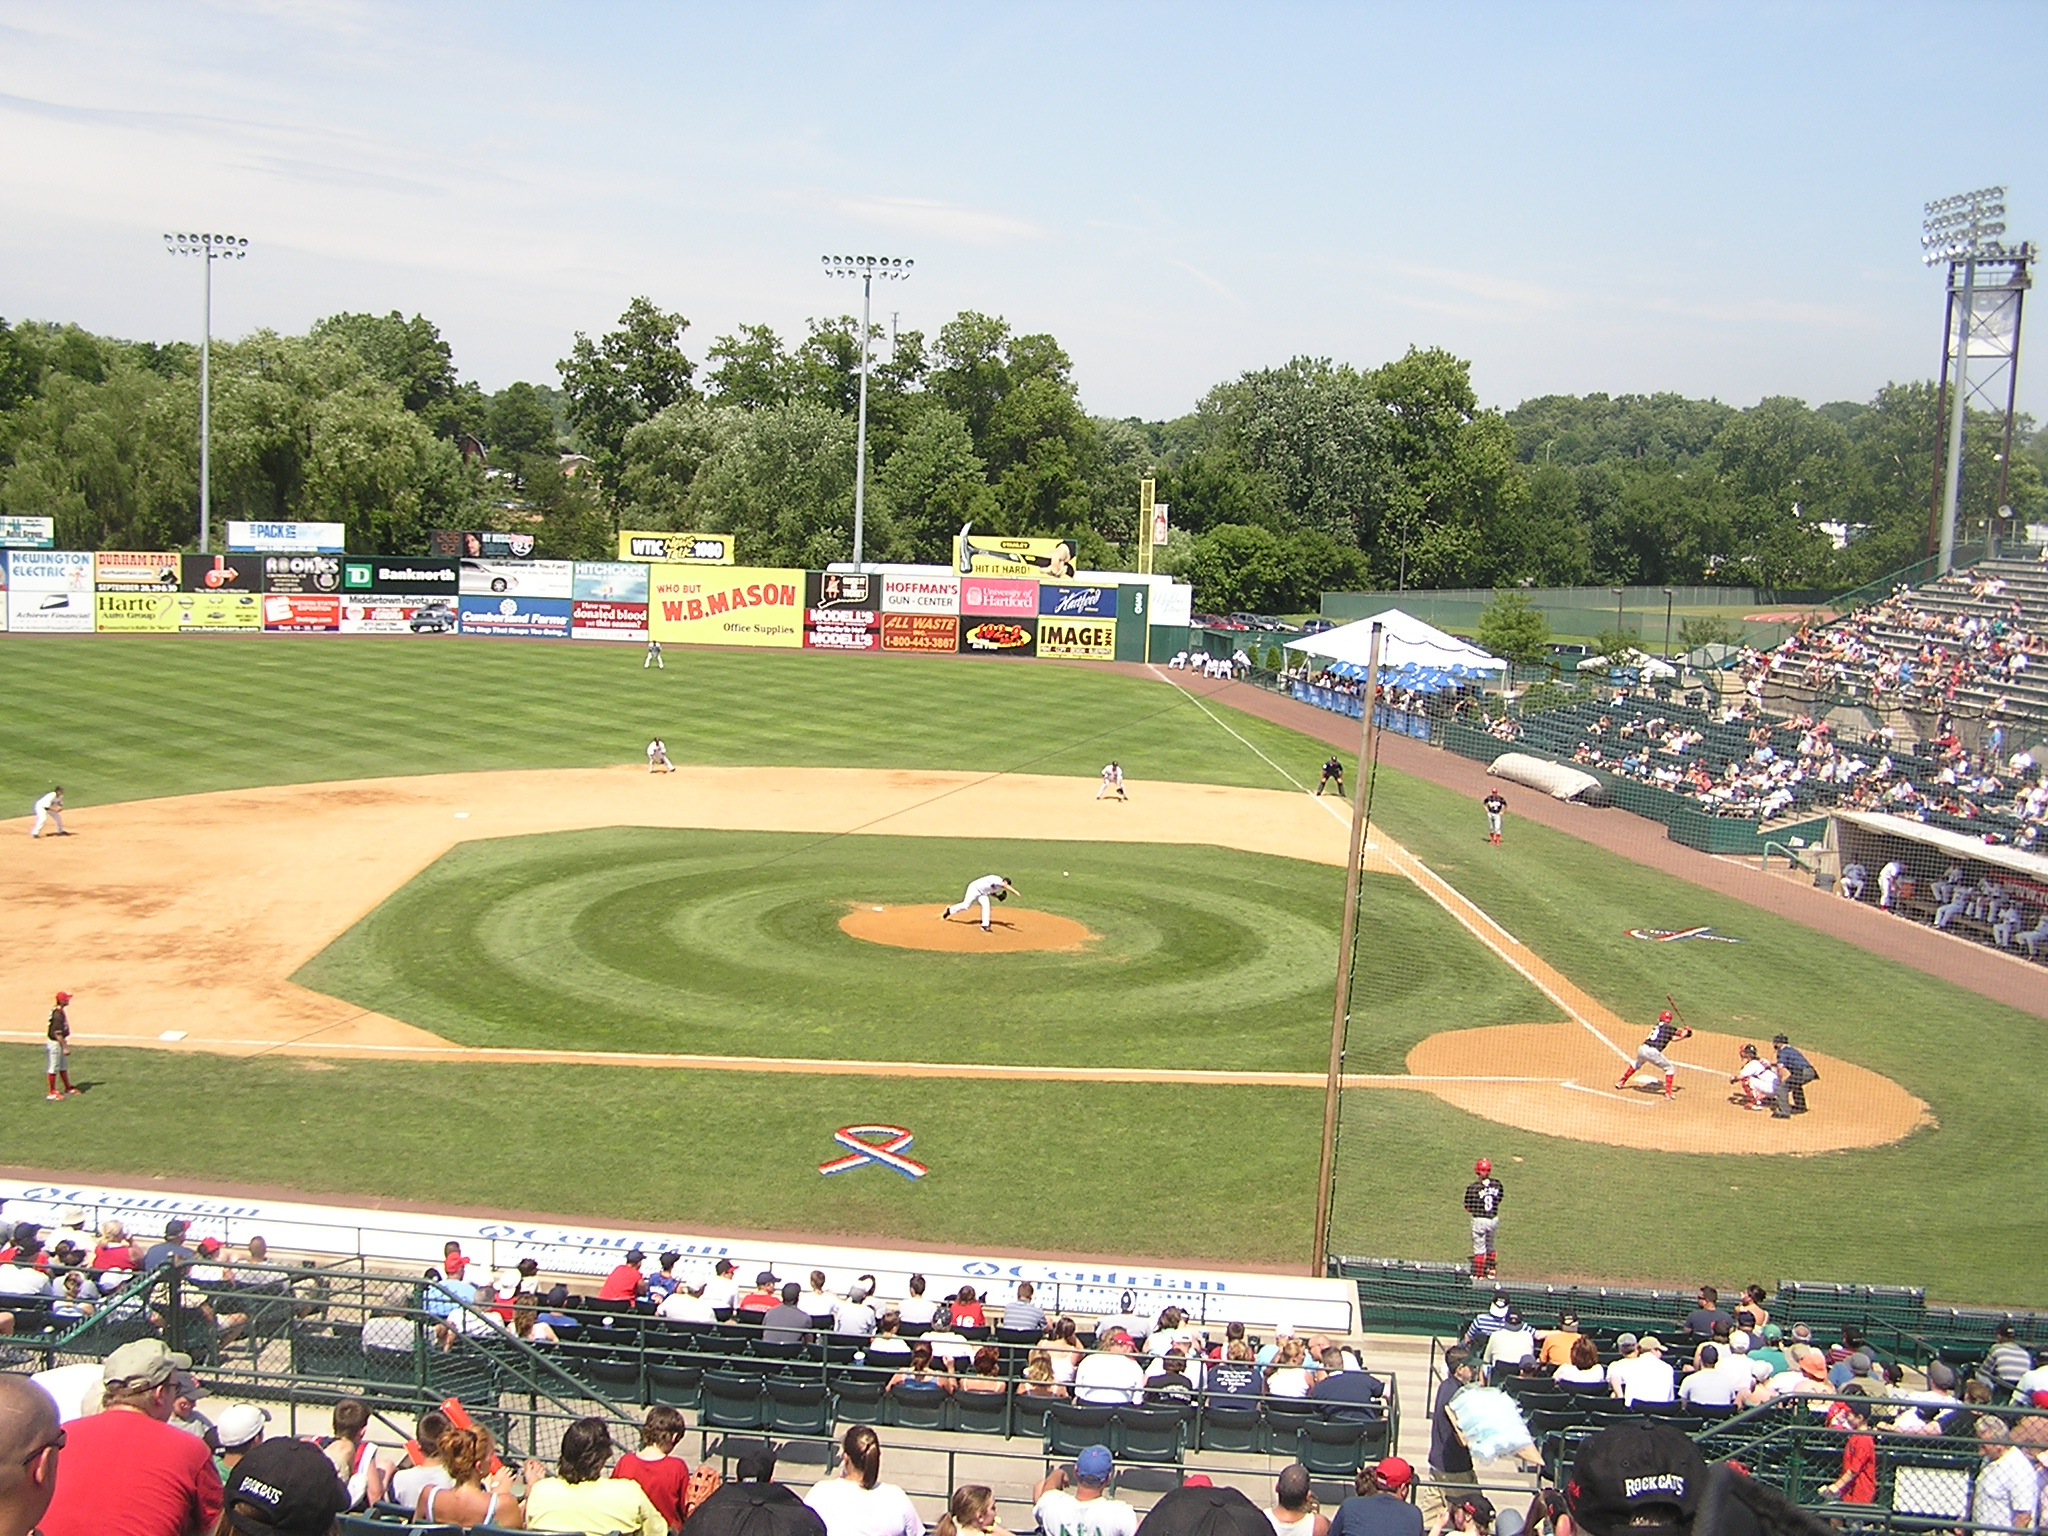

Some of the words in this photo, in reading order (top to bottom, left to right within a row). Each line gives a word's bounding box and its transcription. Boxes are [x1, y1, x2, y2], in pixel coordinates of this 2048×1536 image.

[257, 524, 284, 538] PACK
[632, 539, 664, 556] WTIC
[12, 553, 90, 565] NEWINGTON
[99, 554, 147, 566] DURHAM
[150, 555, 178, 566] FAIR
[13, 566, 66, 577] ELECTRIC
[346, 567, 370, 583] TD
[378, 568, 456, 581] Banknorth
[575, 563, 647, 576] HITCHCOCK
[975, 565, 990, 573] HIT
[992, 565, 999, 573] IT
[1002, 565, 1030, 574] HARD!
[656, 584, 679, 594] WHO
[683, 584, 701, 594] BUT
[886, 582, 958, 595] HOFFMAN'S
[983, 587, 1021, 597] University
[1022, 588, 1033, 598] of
[99, 597, 157, 611] Harte
[888, 595, 910, 605] GUN
[917, 596, 953, 607] CENTER
[983, 595, 1033, 608] Hartford
[461, 611, 530, 624] Cumberland
[531, 613, 567, 625] Farms
[573, 607, 615, 619] donated
[616, 609, 647, 620] blood
[809, 609, 874, 624] MODELL'S
[595, 619, 611, 627] this
[723, 623, 751, 633] Office
[753, 624, 794, 635] Supplies
[885, 617, 909, 629] ALL
[912, 617, 956, 631] WASTE
[809, 631, 873, 646] MODELL'S
[1040, 625, 1103, 646] IMAGE
[1104, 628, 1112, 647] INK
